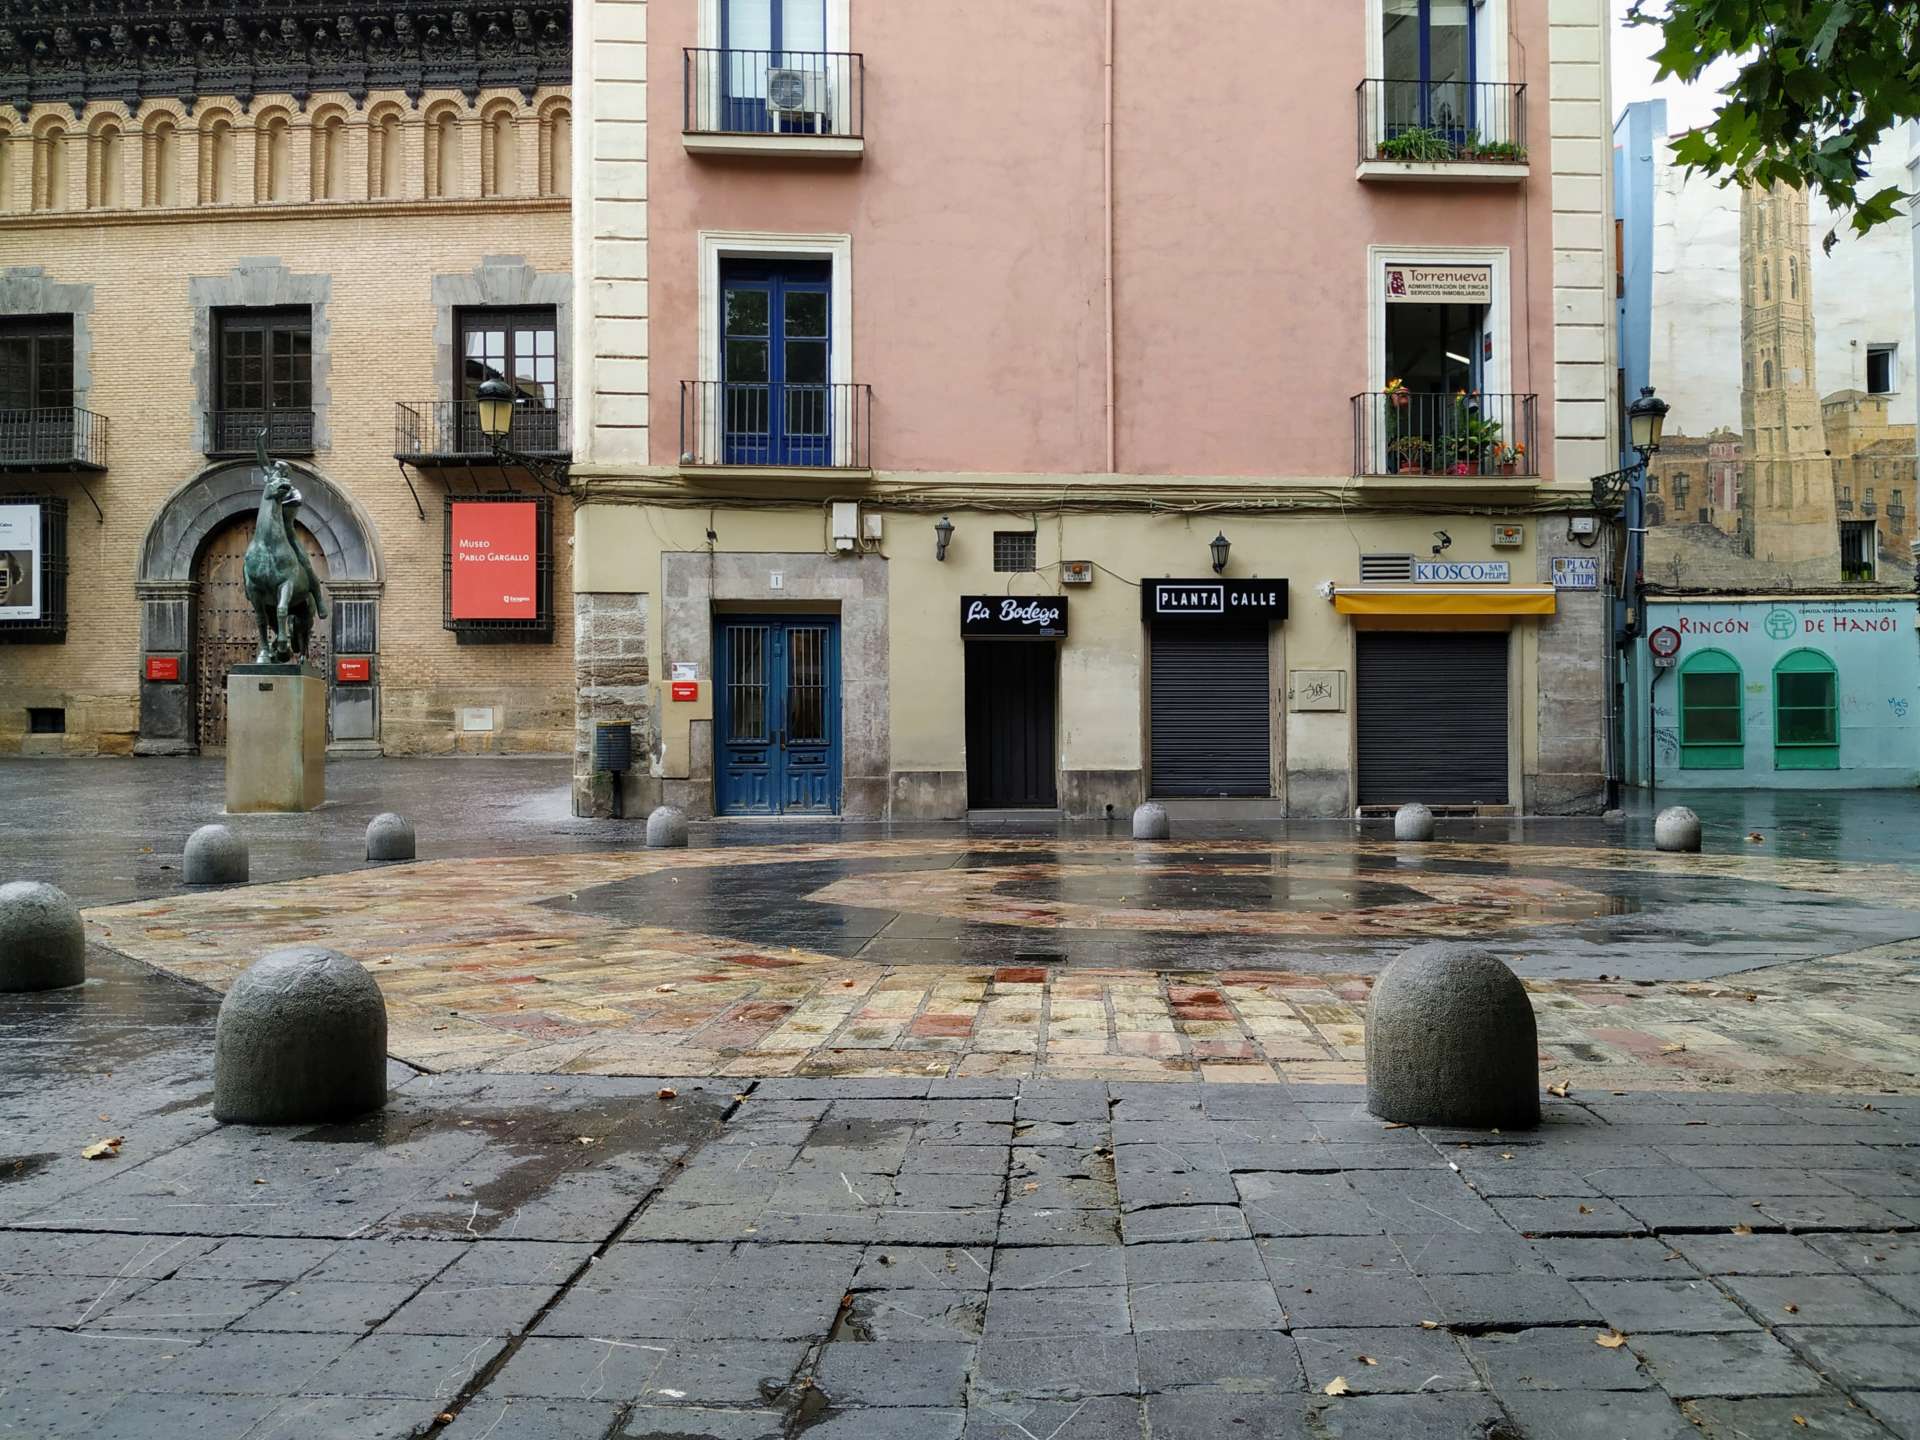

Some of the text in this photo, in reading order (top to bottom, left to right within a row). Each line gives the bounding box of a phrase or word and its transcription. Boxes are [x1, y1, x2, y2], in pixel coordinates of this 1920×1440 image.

[1409, 269, 1487, 282] Torrenueva
[1567, 560, 1598, 569] PLAZA
[1417, 564, 1484, 580] KIOSCO
[1553, 574, 1594, 584] SAN FELIPE
[1161, 592, 1277, 606] PLANTA CALLE
[966, 599, 1060, 626] La Bodega
[1805, 619, 1825, 633] DE
